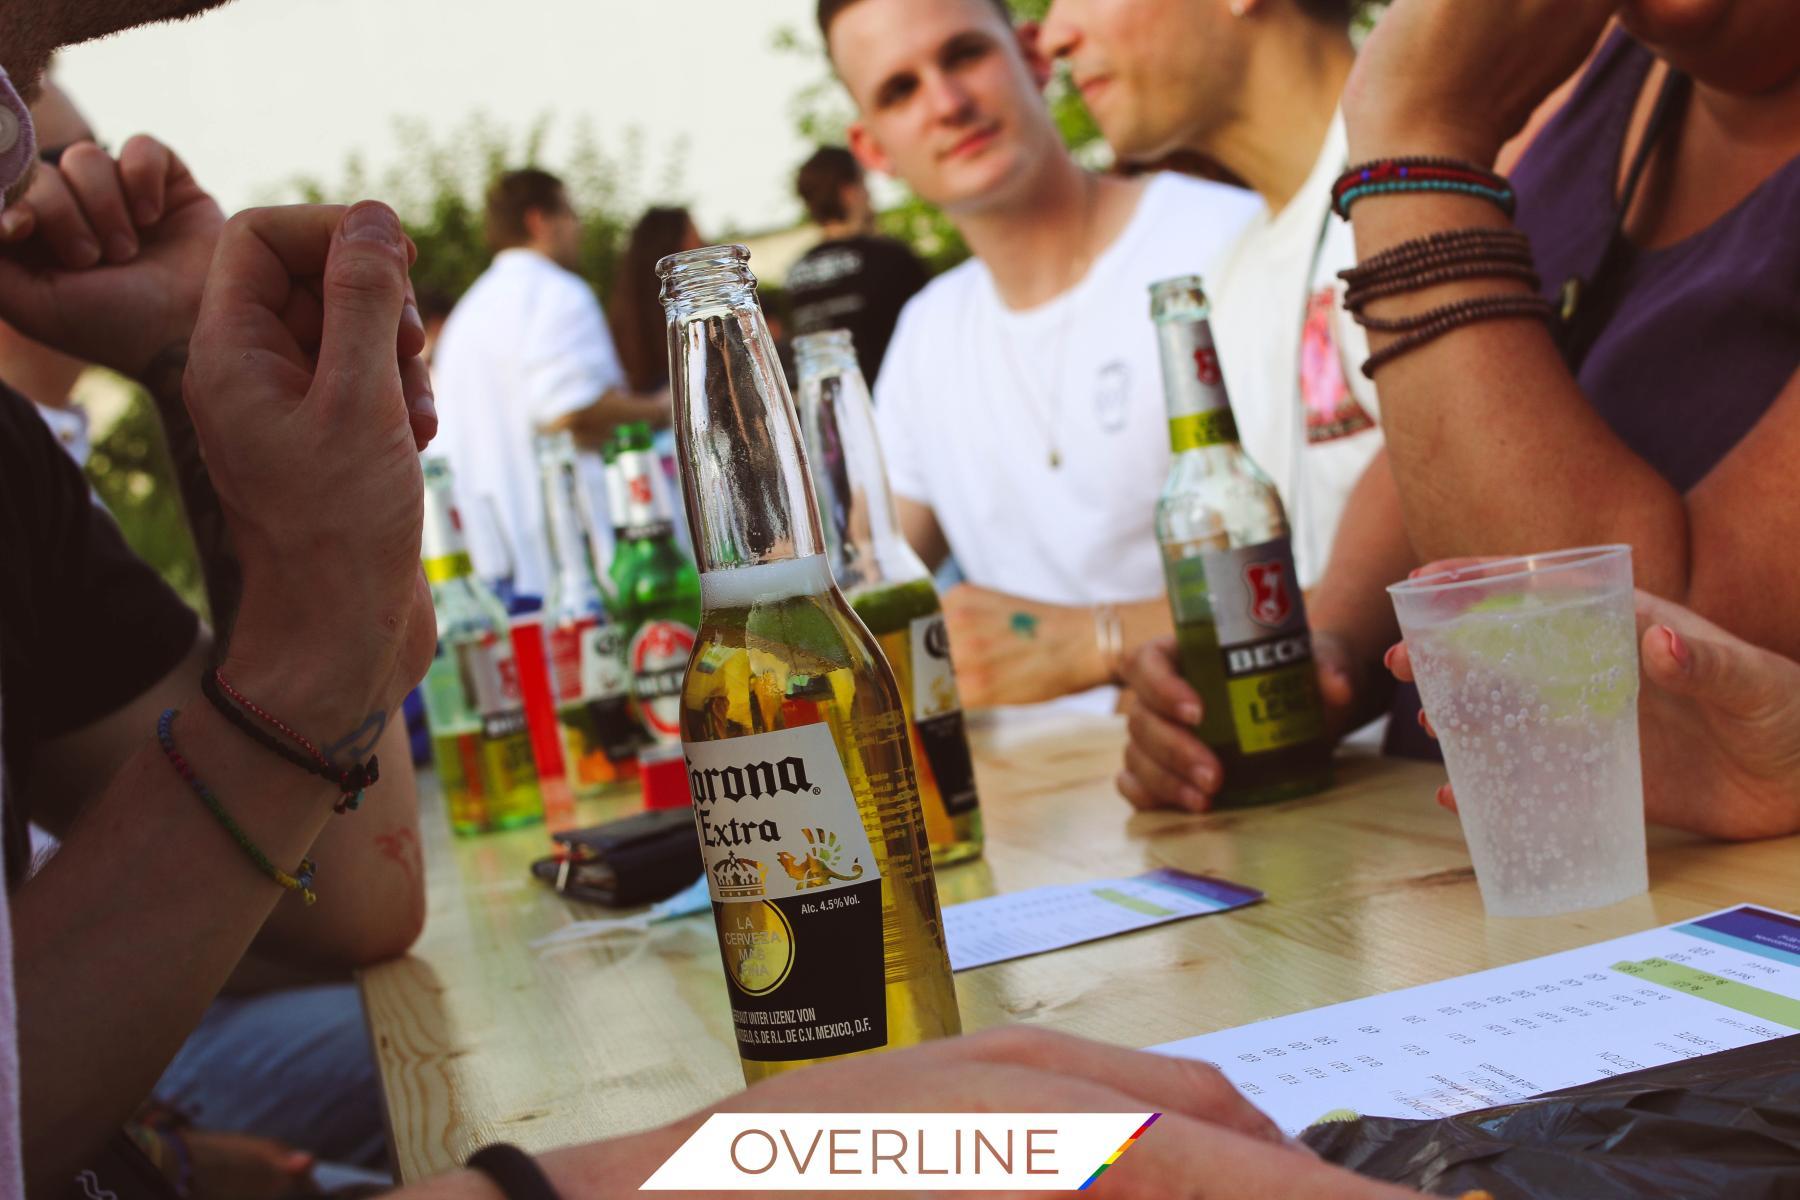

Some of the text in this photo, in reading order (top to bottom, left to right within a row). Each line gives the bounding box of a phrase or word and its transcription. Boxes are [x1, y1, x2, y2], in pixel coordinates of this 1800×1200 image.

[687, 756, 813, 806] orona
[699, 809, 782, 848] Extra
[801, 895, 860, 915] Alc. 4.5% Vol.
[737, 917, 754, 930] LA
[725, 930, 782, 945] CERVEZA
[748, 1010, 768, 1025] UNTER
[769, 1009, 796, 1025] LIZENZ
[796, 1007, 816, 1023] VON
[761, 1030, 771, 1044] DE
[786, 1029, 797, 1043] DE
[798, 1027, 815, 1042] C.V.
[855, 1017, 872, 1033] D.F.
